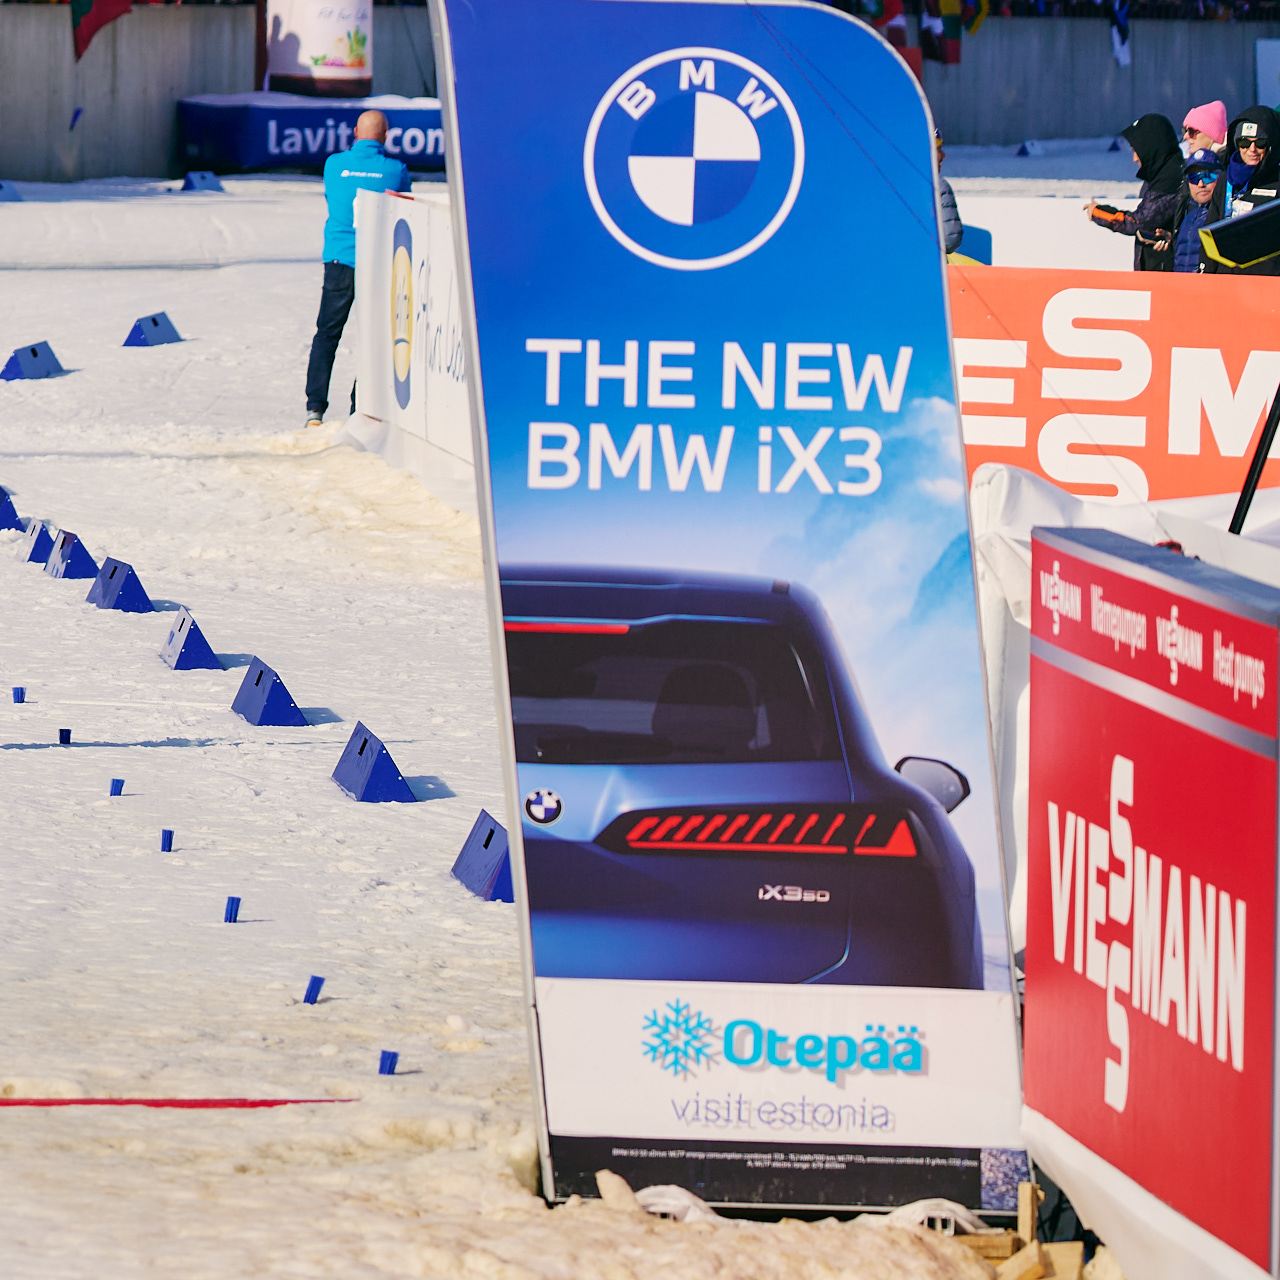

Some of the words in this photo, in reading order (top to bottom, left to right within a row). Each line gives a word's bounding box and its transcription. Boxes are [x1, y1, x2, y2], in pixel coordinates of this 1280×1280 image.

[617, 60, 778, 121] BMW
[525, 338, 696, 409] THE
[721, 341, 913, 413] NEW
[526, 421, 735, 493] BMW
[757, 424, 883, 496] iX3
[1047, 754, 1246, 1114] VIESSMANN
[723, 1019, 923, 1083] Otepää
[671, 1091, 751, 1123] visit
[757, 1095, 891, 1129] estonia
